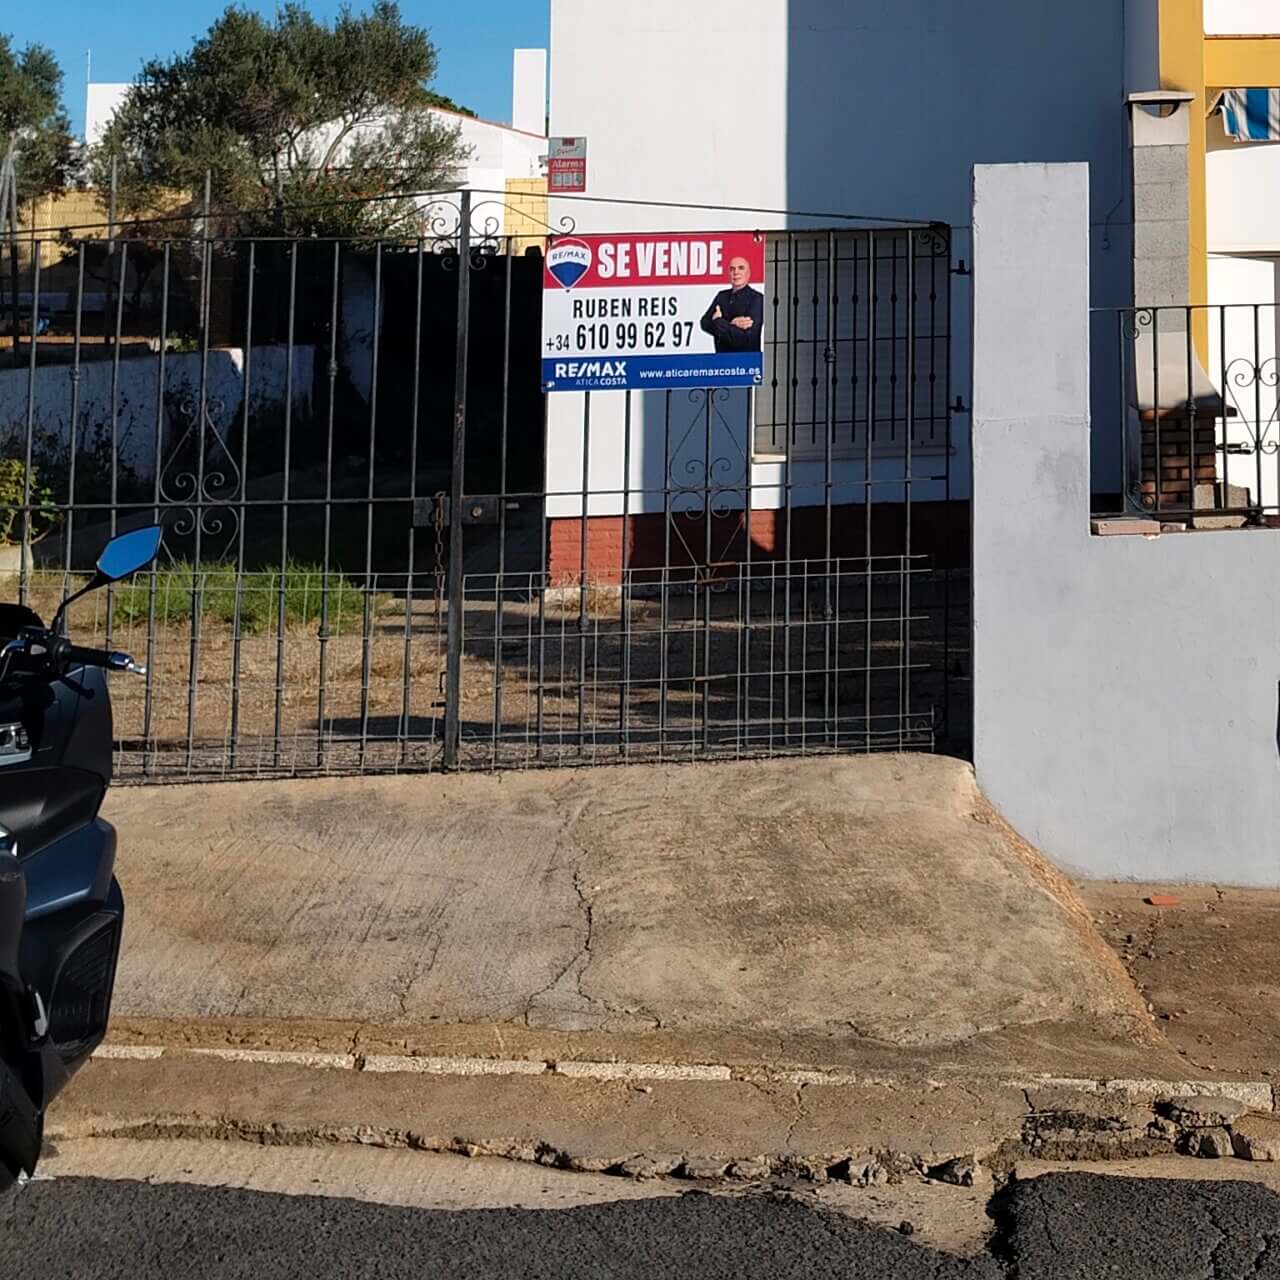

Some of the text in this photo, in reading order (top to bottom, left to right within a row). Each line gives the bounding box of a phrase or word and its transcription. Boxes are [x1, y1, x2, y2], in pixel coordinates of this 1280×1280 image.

[552, 250, 586, 260] RE/MAX
[597, 240, 723, 278] SE VENDE
[573, 297, 678, 318] RUBEN REIS
[546, 321, 694, 351] +34 610 99 62 97
[555, 361, 627, 378] RE/MAX
[639, 367, 761, 379] www.aticaremaxcosta.es
[576, 377, 627, 386] ATICA COSTA
